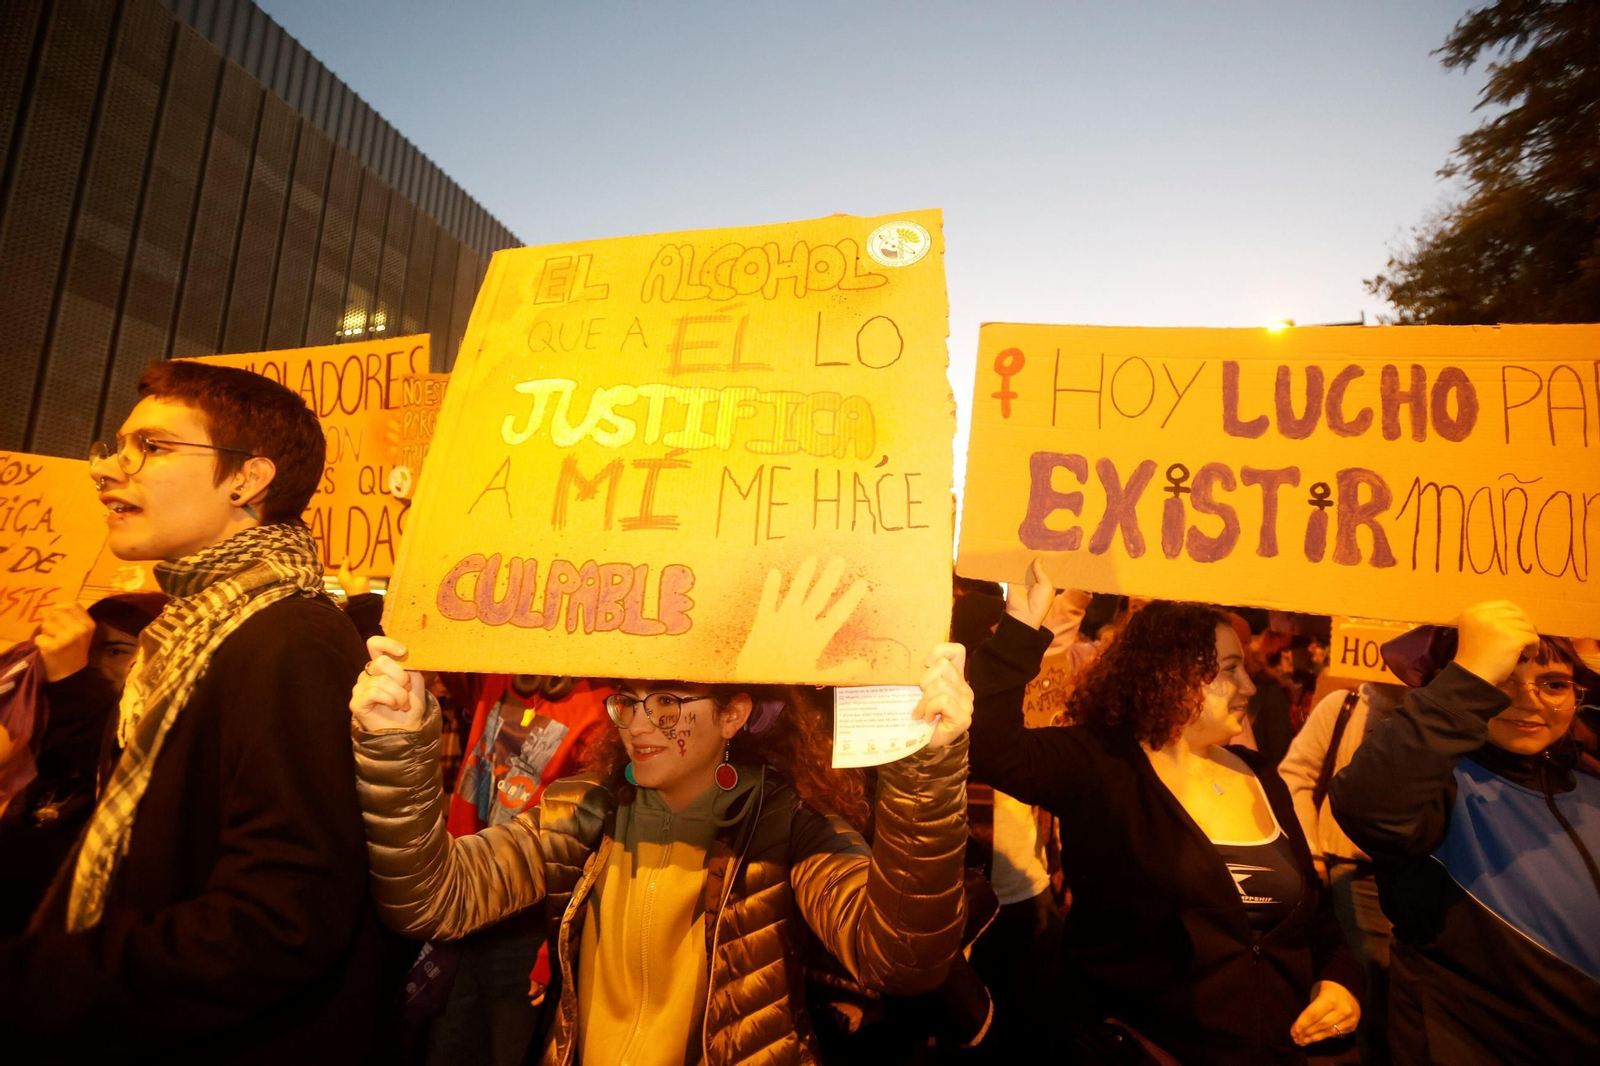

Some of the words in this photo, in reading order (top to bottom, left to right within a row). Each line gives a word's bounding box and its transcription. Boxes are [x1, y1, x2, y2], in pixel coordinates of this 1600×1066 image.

[532, 253, 609, 306] EL
[640, 237, 889, 302] ALCOHOL
[527, 317, 606, 353] QUE
[620, 317, 647, 351] A
[664, 303, 774, 375] ÉL
[814, 311, 904, 369] LO
[1052, 348, 1206, 429] HOY
[1222, 359, 1480, 443] LUCHO
[0, 454, 43, 486] OY
[358, 464, 396, 496] QU
[467, 456, 513, 519] A
[551, 447, 693, 532] MÍ
[715, 464, 791, 546] ME
[813, 467, 930, 534] HACE
[304, 505, 410, 571] ALDA
[437, 553, 696, 635] CULPABLE
